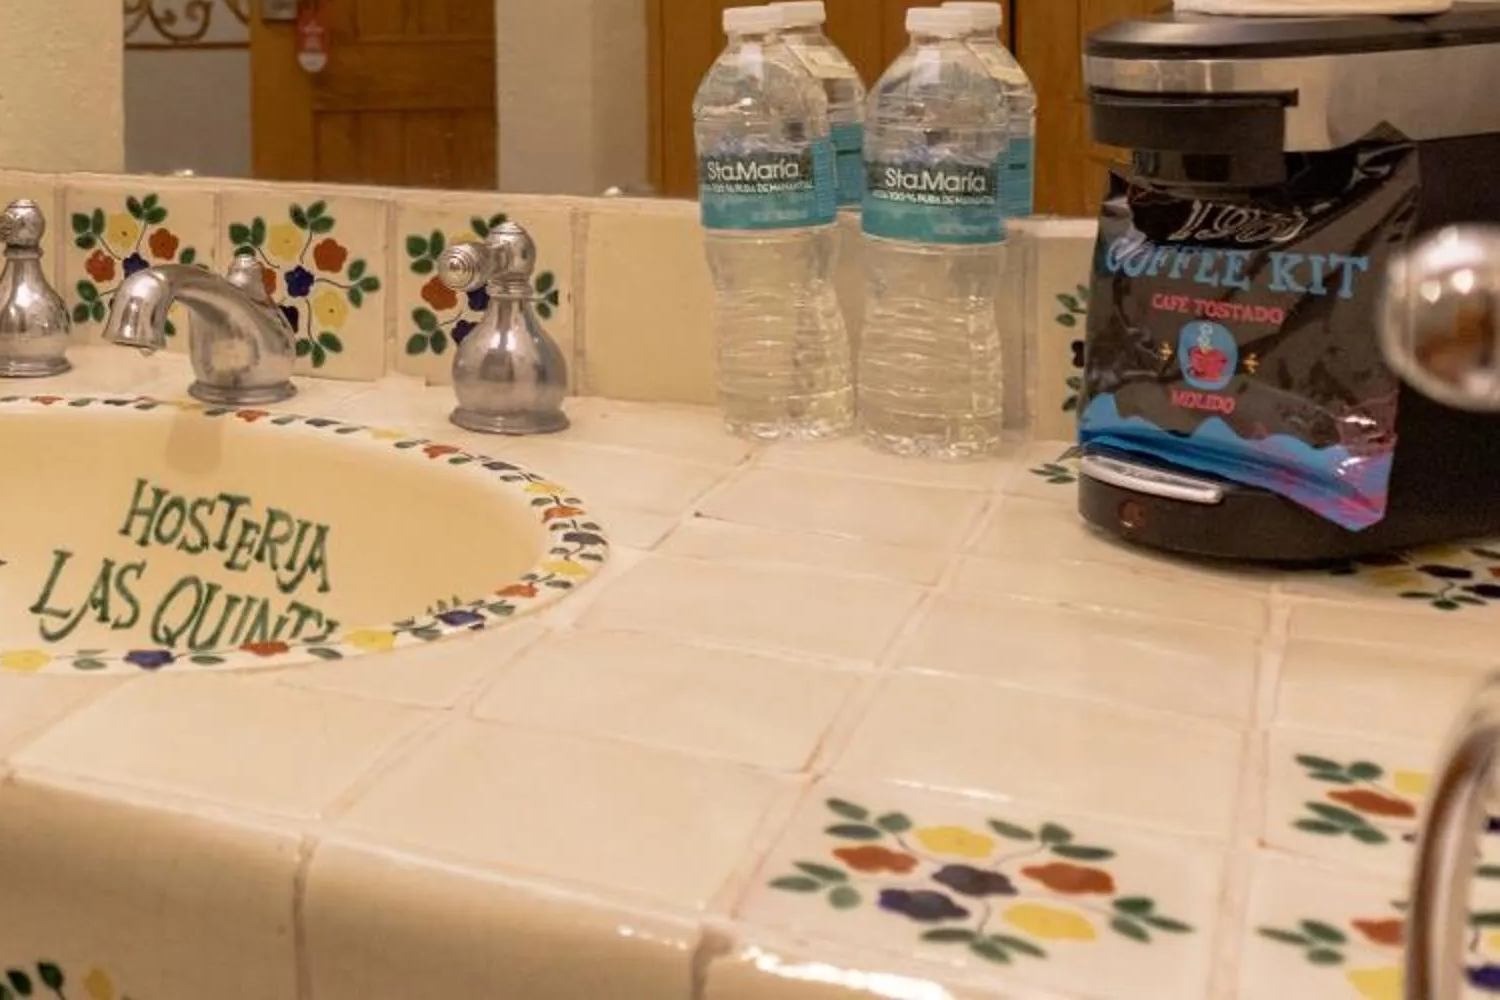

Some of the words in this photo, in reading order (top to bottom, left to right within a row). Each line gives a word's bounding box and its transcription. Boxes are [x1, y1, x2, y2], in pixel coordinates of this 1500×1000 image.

[1105, 237, 1249, 292] COFFEE
[1267, 252, 1369, 299] KIT
[1194, 299, 1285, 326] TOSTADO
[1171, 389, 1236, 414] MOLIDO
[118, 477, 331, 595] HOSTERIA
[28, 549, 147, 643] LAS
